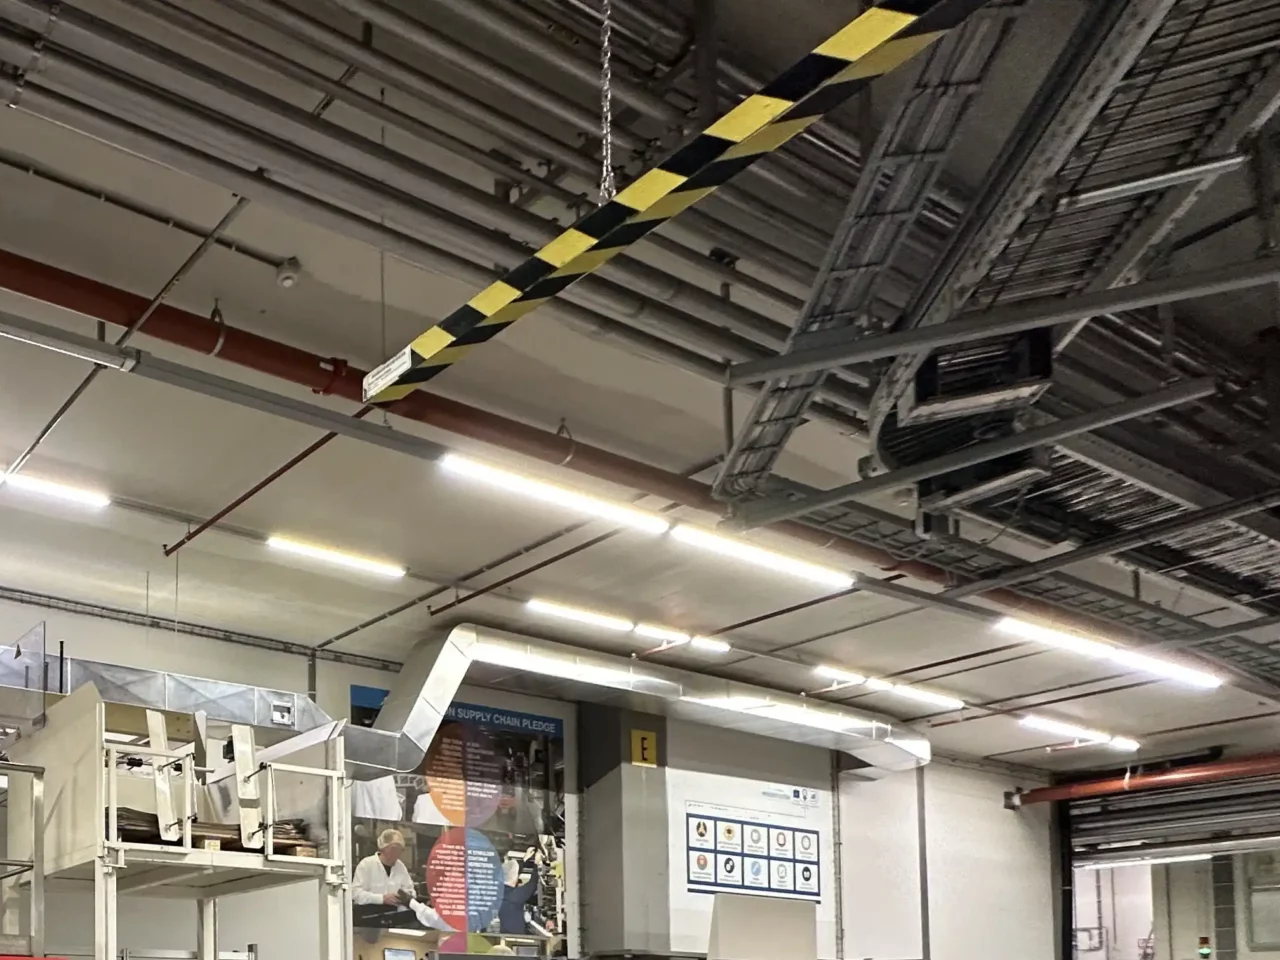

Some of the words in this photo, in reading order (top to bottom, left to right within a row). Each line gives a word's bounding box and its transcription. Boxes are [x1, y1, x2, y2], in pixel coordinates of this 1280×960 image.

[457, 708, 491, 722] SUPPLY
[493, 714, 520, 727] CHAIN
[522, 718, 556, 733] PLEDGE
[640, 736, 648, 762] E
